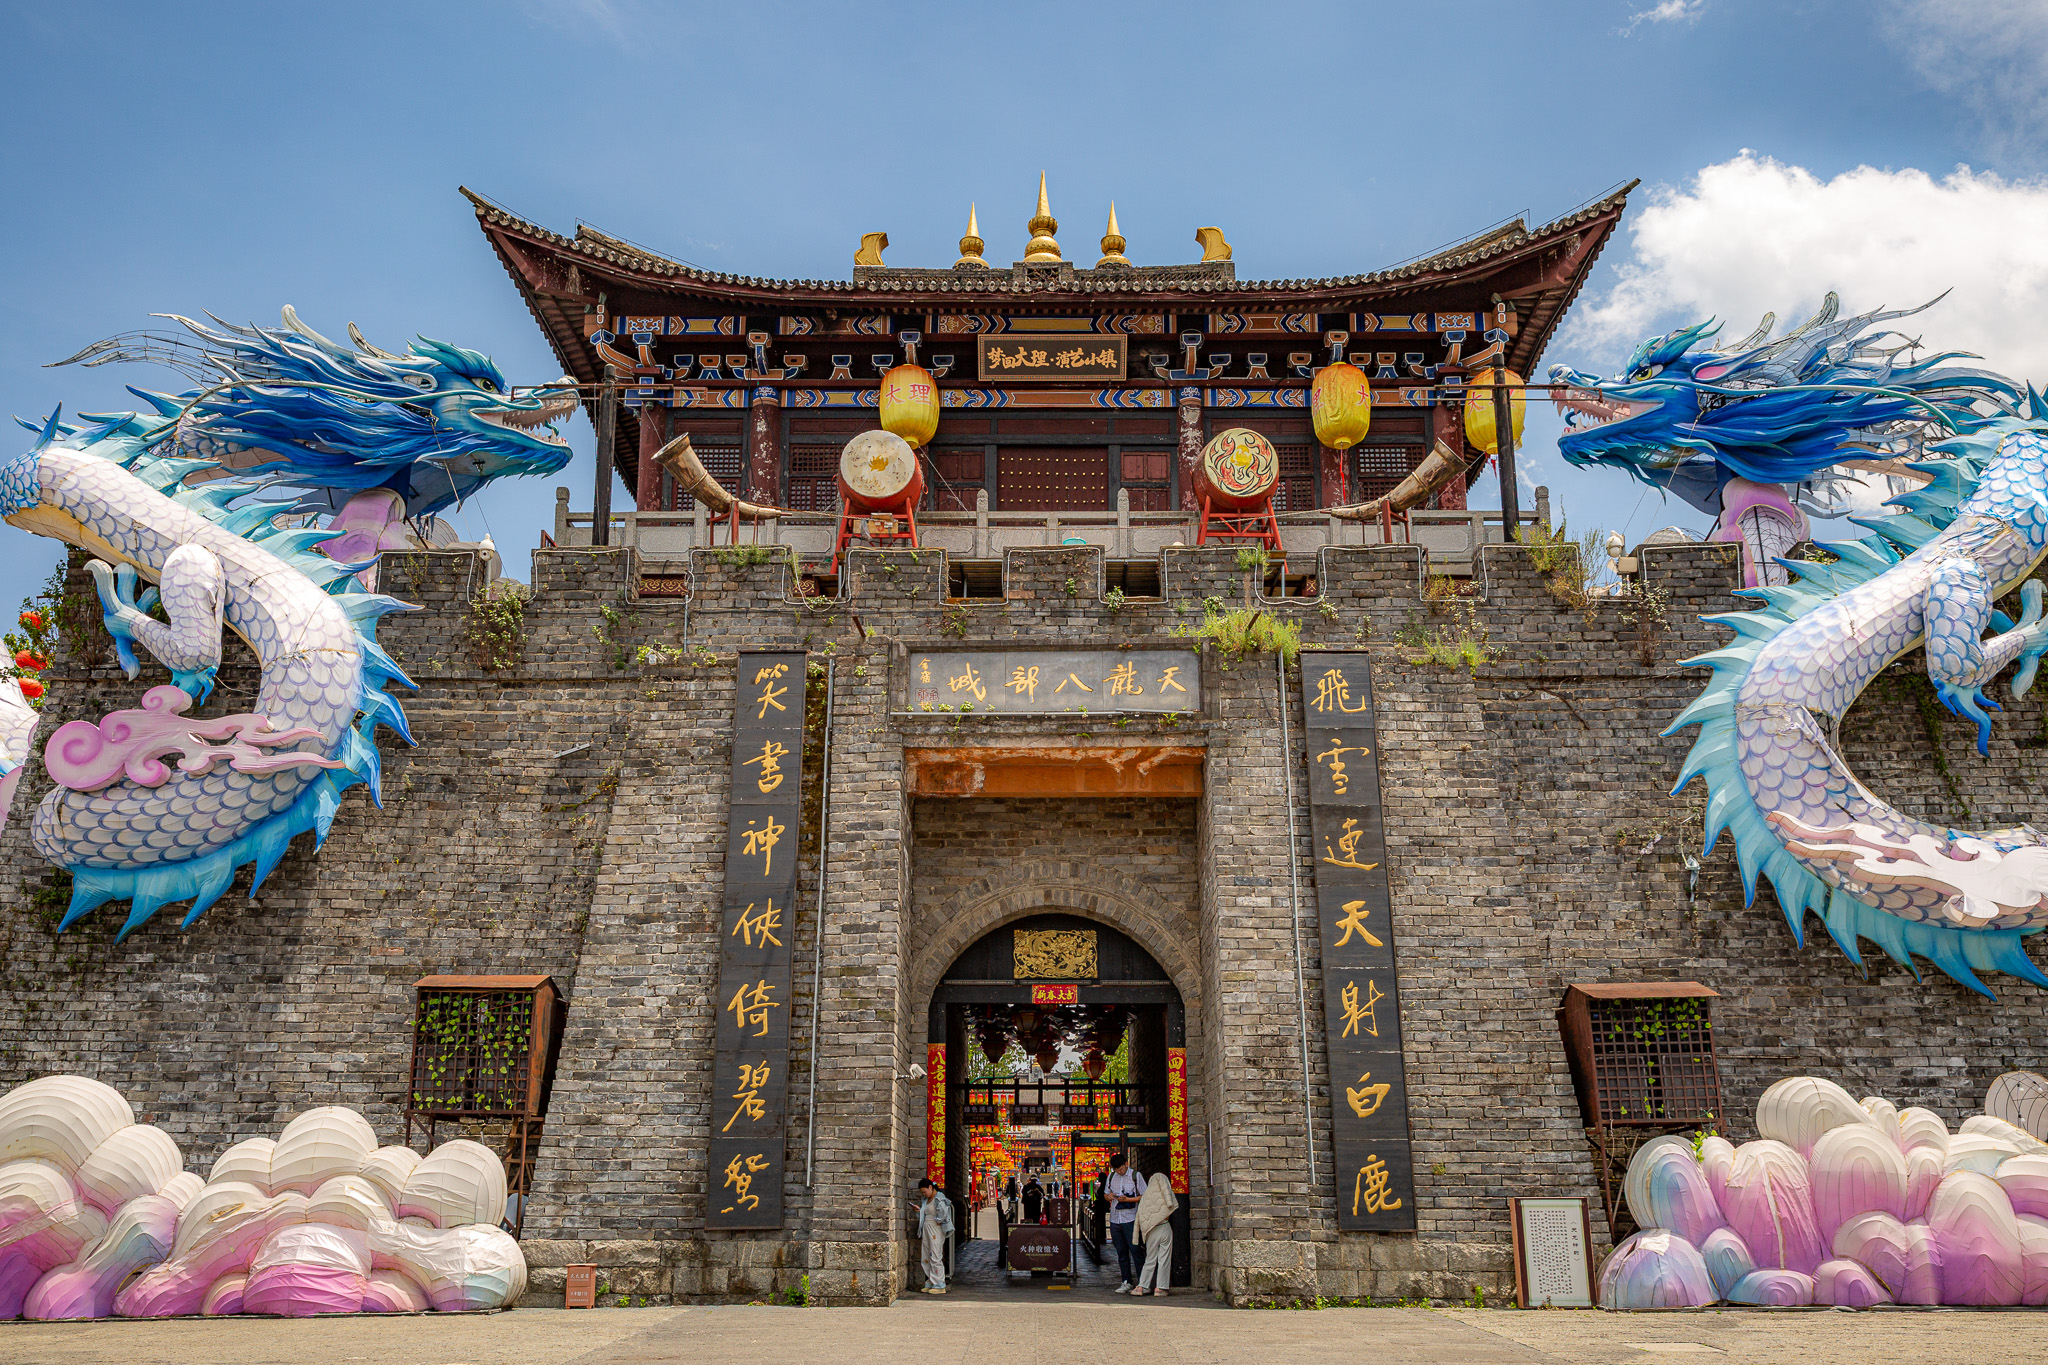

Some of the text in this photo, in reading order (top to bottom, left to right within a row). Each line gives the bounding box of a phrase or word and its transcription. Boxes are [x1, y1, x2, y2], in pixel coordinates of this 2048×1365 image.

[987, 347, 1118, 369] 梦回大理·演艺小镇
[884, 382, 932, 409] 大理
[1356, 384, 1370, 411] 大
[1310, 668, 1402, 1217] 飛雪連天射白鹿
[1036, 989, 1074, 1001] 新春大吉
